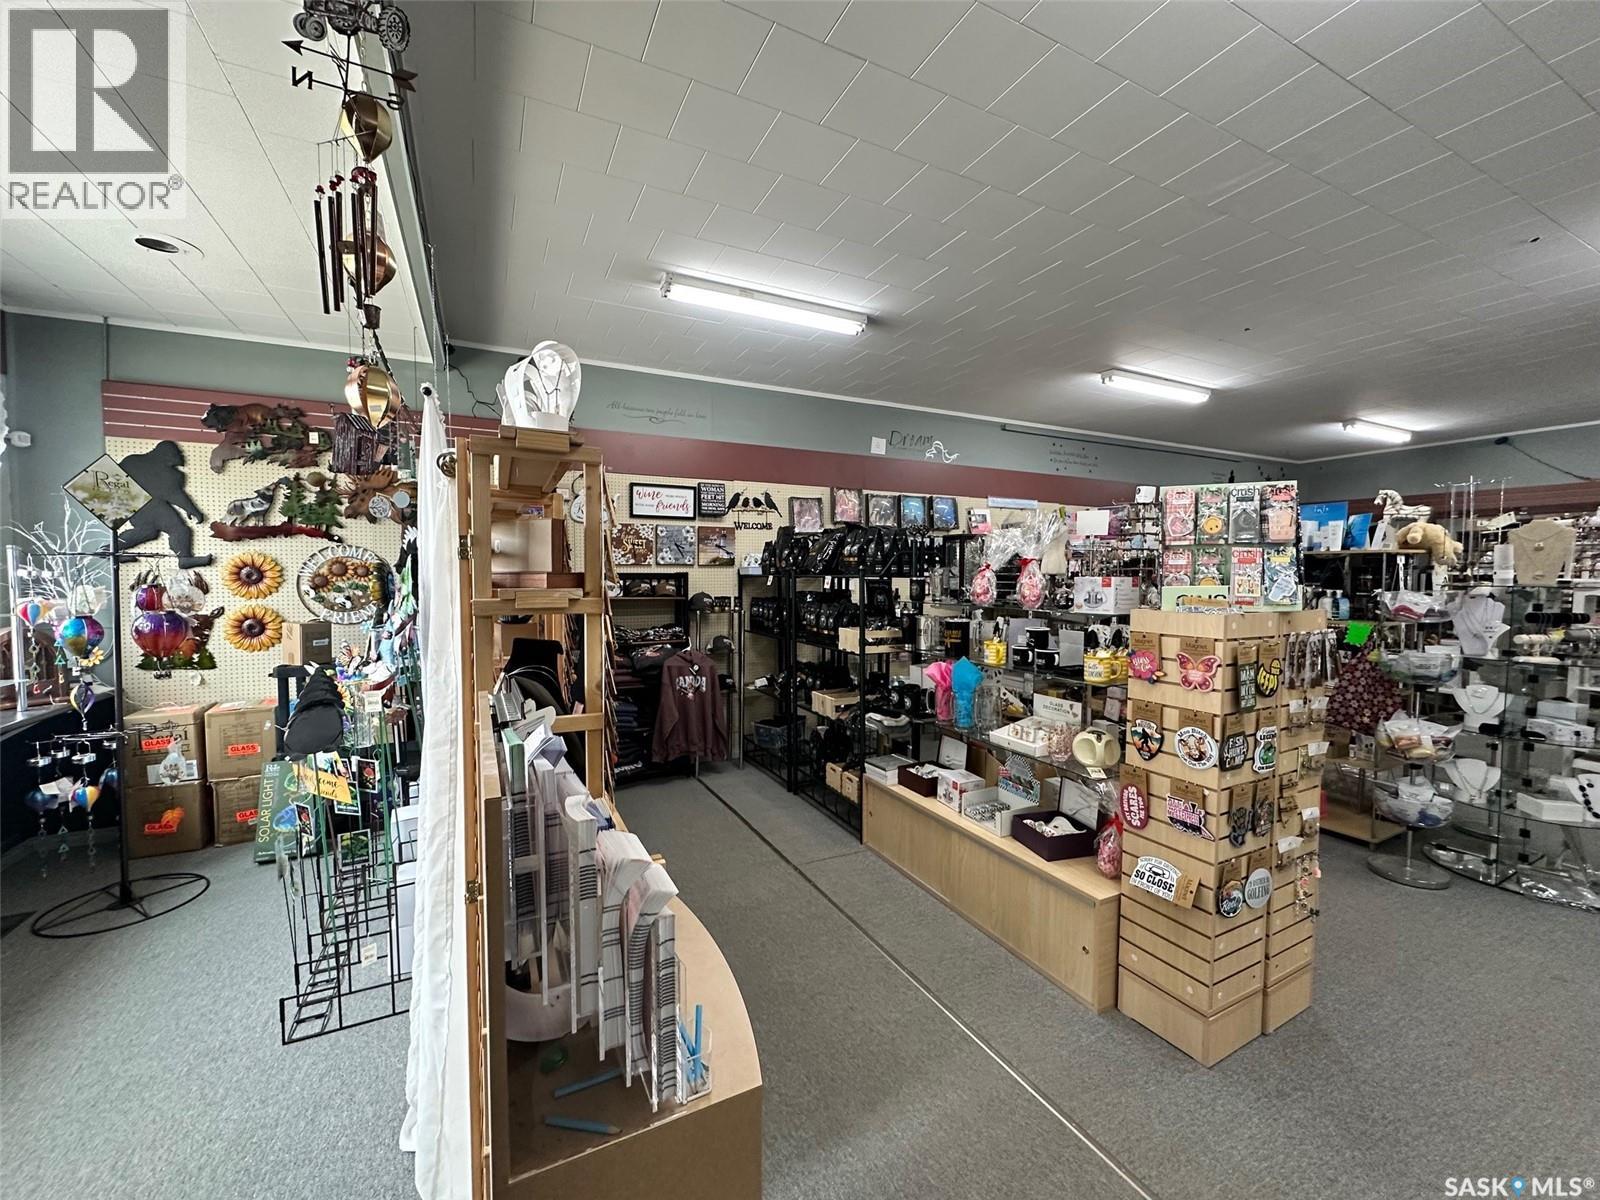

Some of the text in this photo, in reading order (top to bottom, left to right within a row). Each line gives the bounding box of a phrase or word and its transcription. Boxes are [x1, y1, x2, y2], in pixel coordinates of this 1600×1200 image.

[91, 469, 131, 493] Regal
[634, 488, 663, 501] wine
[1231, 485, 1260, 498] crush
[655, 499, 690, 514] friends
[733, 521, 773, 531] WELCOME
[144, 739, 171, 747] GLASS
[230, 744, 257, 752] GLASS
[262, 778, 275, 810] LIGHT
[1127, 785, 1141, 827] SCARES
[258, 811, 271, 843] SOLAR
[1134, 869, 1175, 893] SO CLOSE
[1137, 880, 1154, 891] FRONT
[1247, 884, 1271, 900] GOLFING
